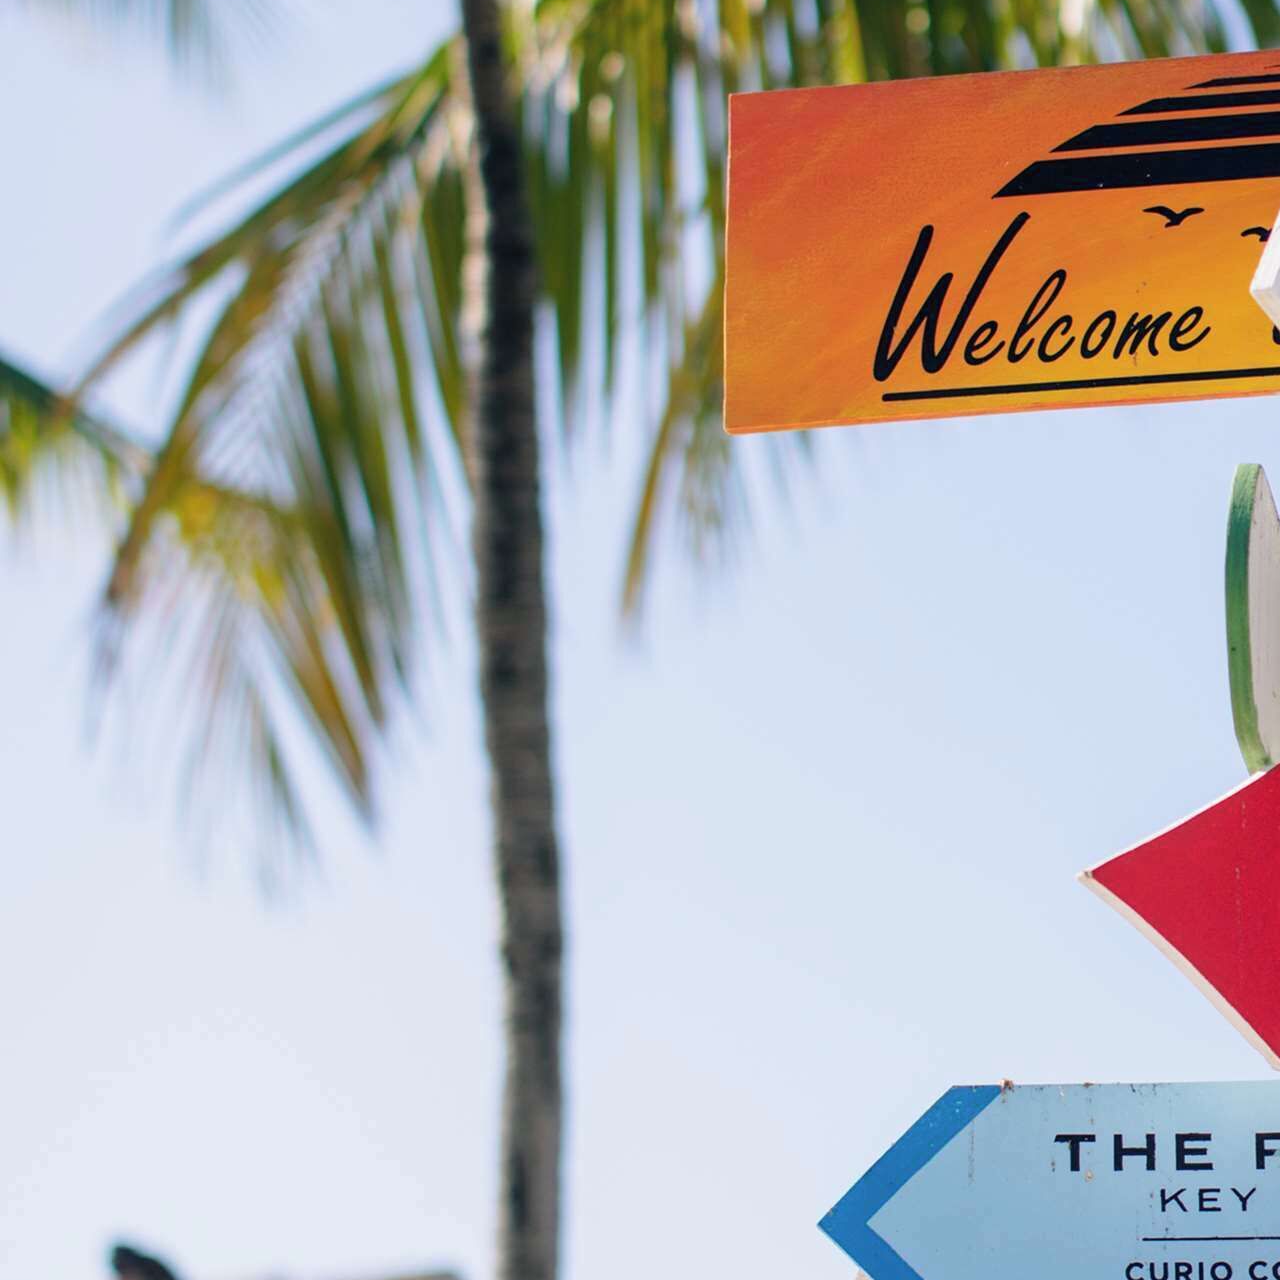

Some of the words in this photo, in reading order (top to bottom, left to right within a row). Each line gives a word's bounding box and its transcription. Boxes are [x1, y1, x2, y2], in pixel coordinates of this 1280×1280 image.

[873, 211, 1210, 381] Welcome
[1054, 1132, 1214, 1172] THE
[1160, 1187, 1257, 1213] KEY
